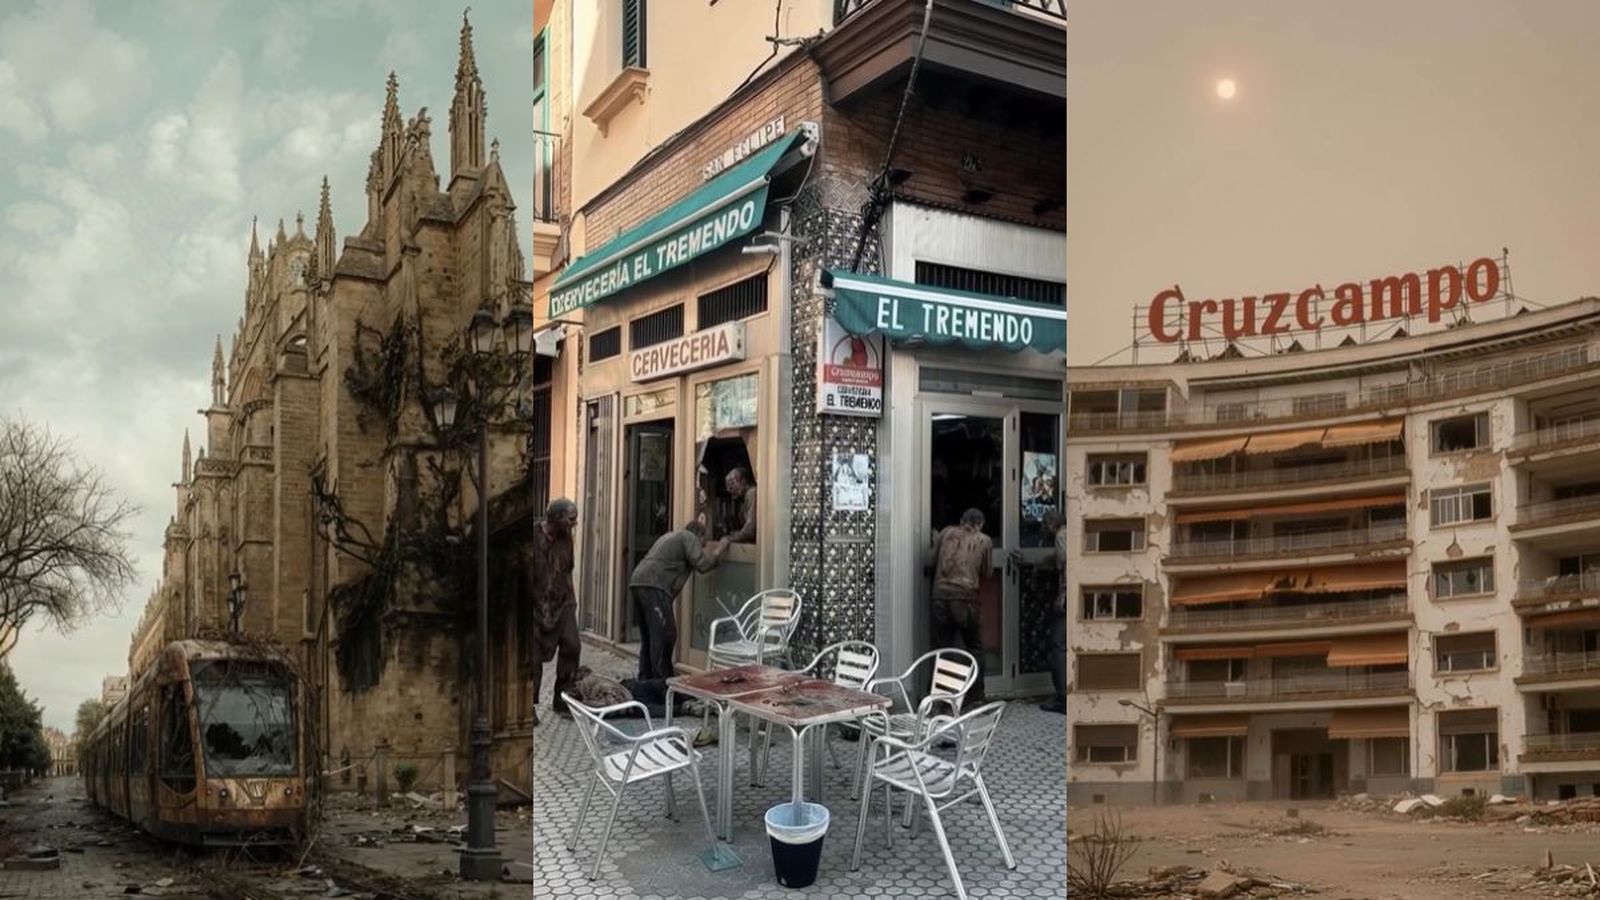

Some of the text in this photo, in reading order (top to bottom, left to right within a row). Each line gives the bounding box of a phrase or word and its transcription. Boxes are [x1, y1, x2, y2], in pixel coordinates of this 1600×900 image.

[633, 252, 652, 281] EL
[656, 200, 755, 270] TREMENDO
[877, 297, 1033, 345] EL TREMENDO
[1148, 257, 1500, 343] Cruzcampo
